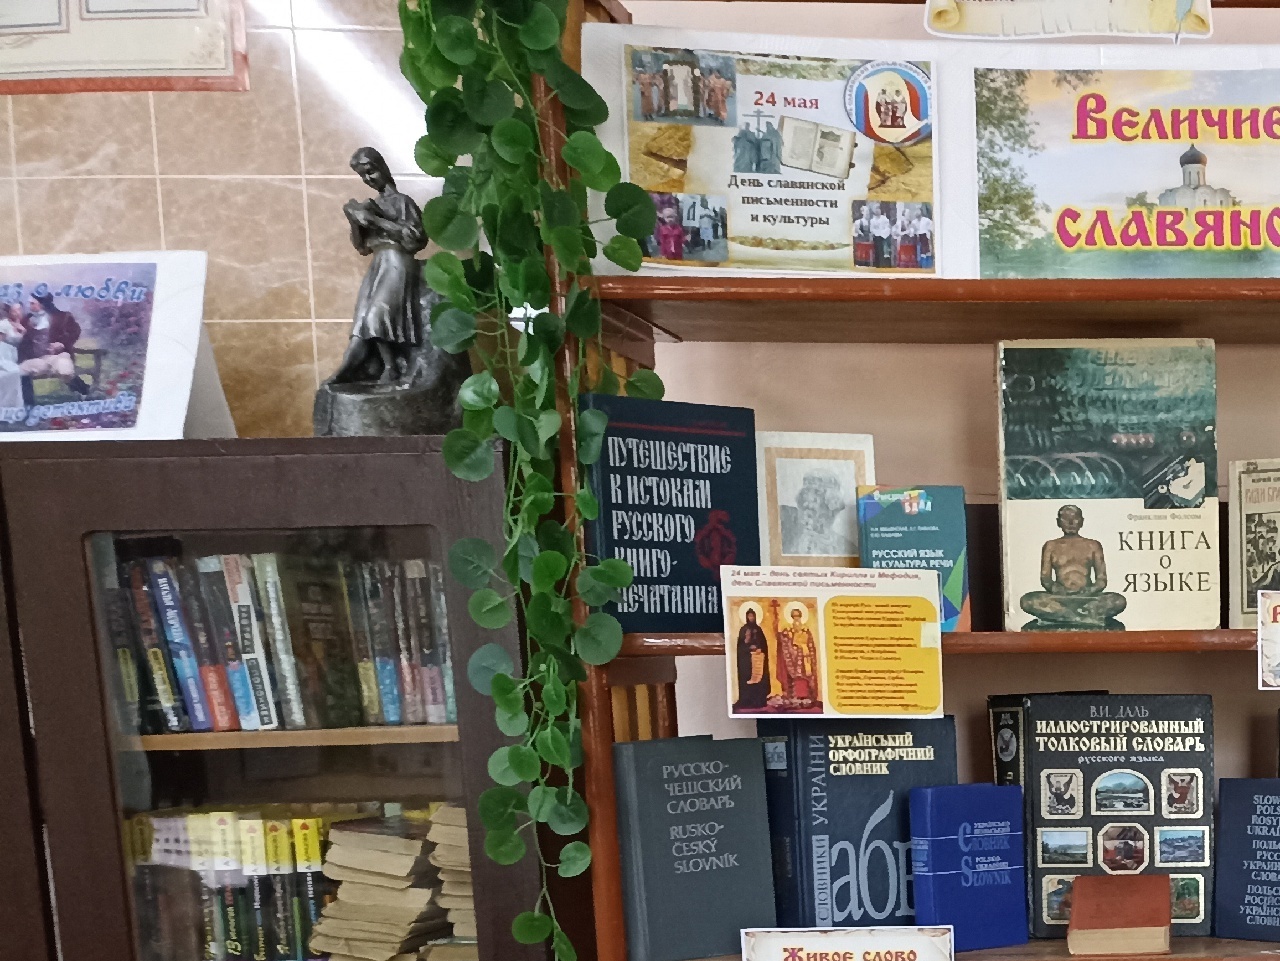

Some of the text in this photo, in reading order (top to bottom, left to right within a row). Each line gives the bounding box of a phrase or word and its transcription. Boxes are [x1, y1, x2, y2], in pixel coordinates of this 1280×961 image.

[753, 91, 819, 111] 24 мая
[727, 174, 845, 192] День славянской
[741, 194, 838, 210] письменности
[750, 212, 830, 228] и культуры
[607, 436, 732, 475] ПУТЕШЕСТВИЕ
[610, 474, 712, 509] К ИСТОКАМ
[612, 510, 695, 543] РУССКОГО
[1117, 530, 1212, 551] КНИГА
[872, 549, 944, 559] РУССКИЙ ЯЗЫК
[873, 559, 953, 568] И КУЛЬТУРА РЕЧИ
[1122, 571, 1212, 592] ЯЗЫКЕ
[1115, 705, 1149, 719] ДАЛЬ
[1035, 718, 1205, 734] ИЛЛЮСТРИРОВАННЫЙ
[828, 732, 914, 748] УКРАЇНСЬКИЙ
[1035, 734, 1206, 752] ТОЛКОВЫЙ СЛОВАРЬ
[828, 746, 934, 762] ОРФОГРАФІЧНИЙ
[1078, 755, 1165, 765] русского языка
[662, 760, 729, 779] РУССКО-
[829, 763, 890, 776] СЛОВНИК
[664, 775, 742, 796] ЧЕШСКИЙ
[808, 734, 828, 826] УКРАЇНИ
[666, 796, 735, 814] СЛОВАРЬ
[669, 821, 725, 840] RUSKO-
[816, 838, 829, 922] СЛОВНИКИ
